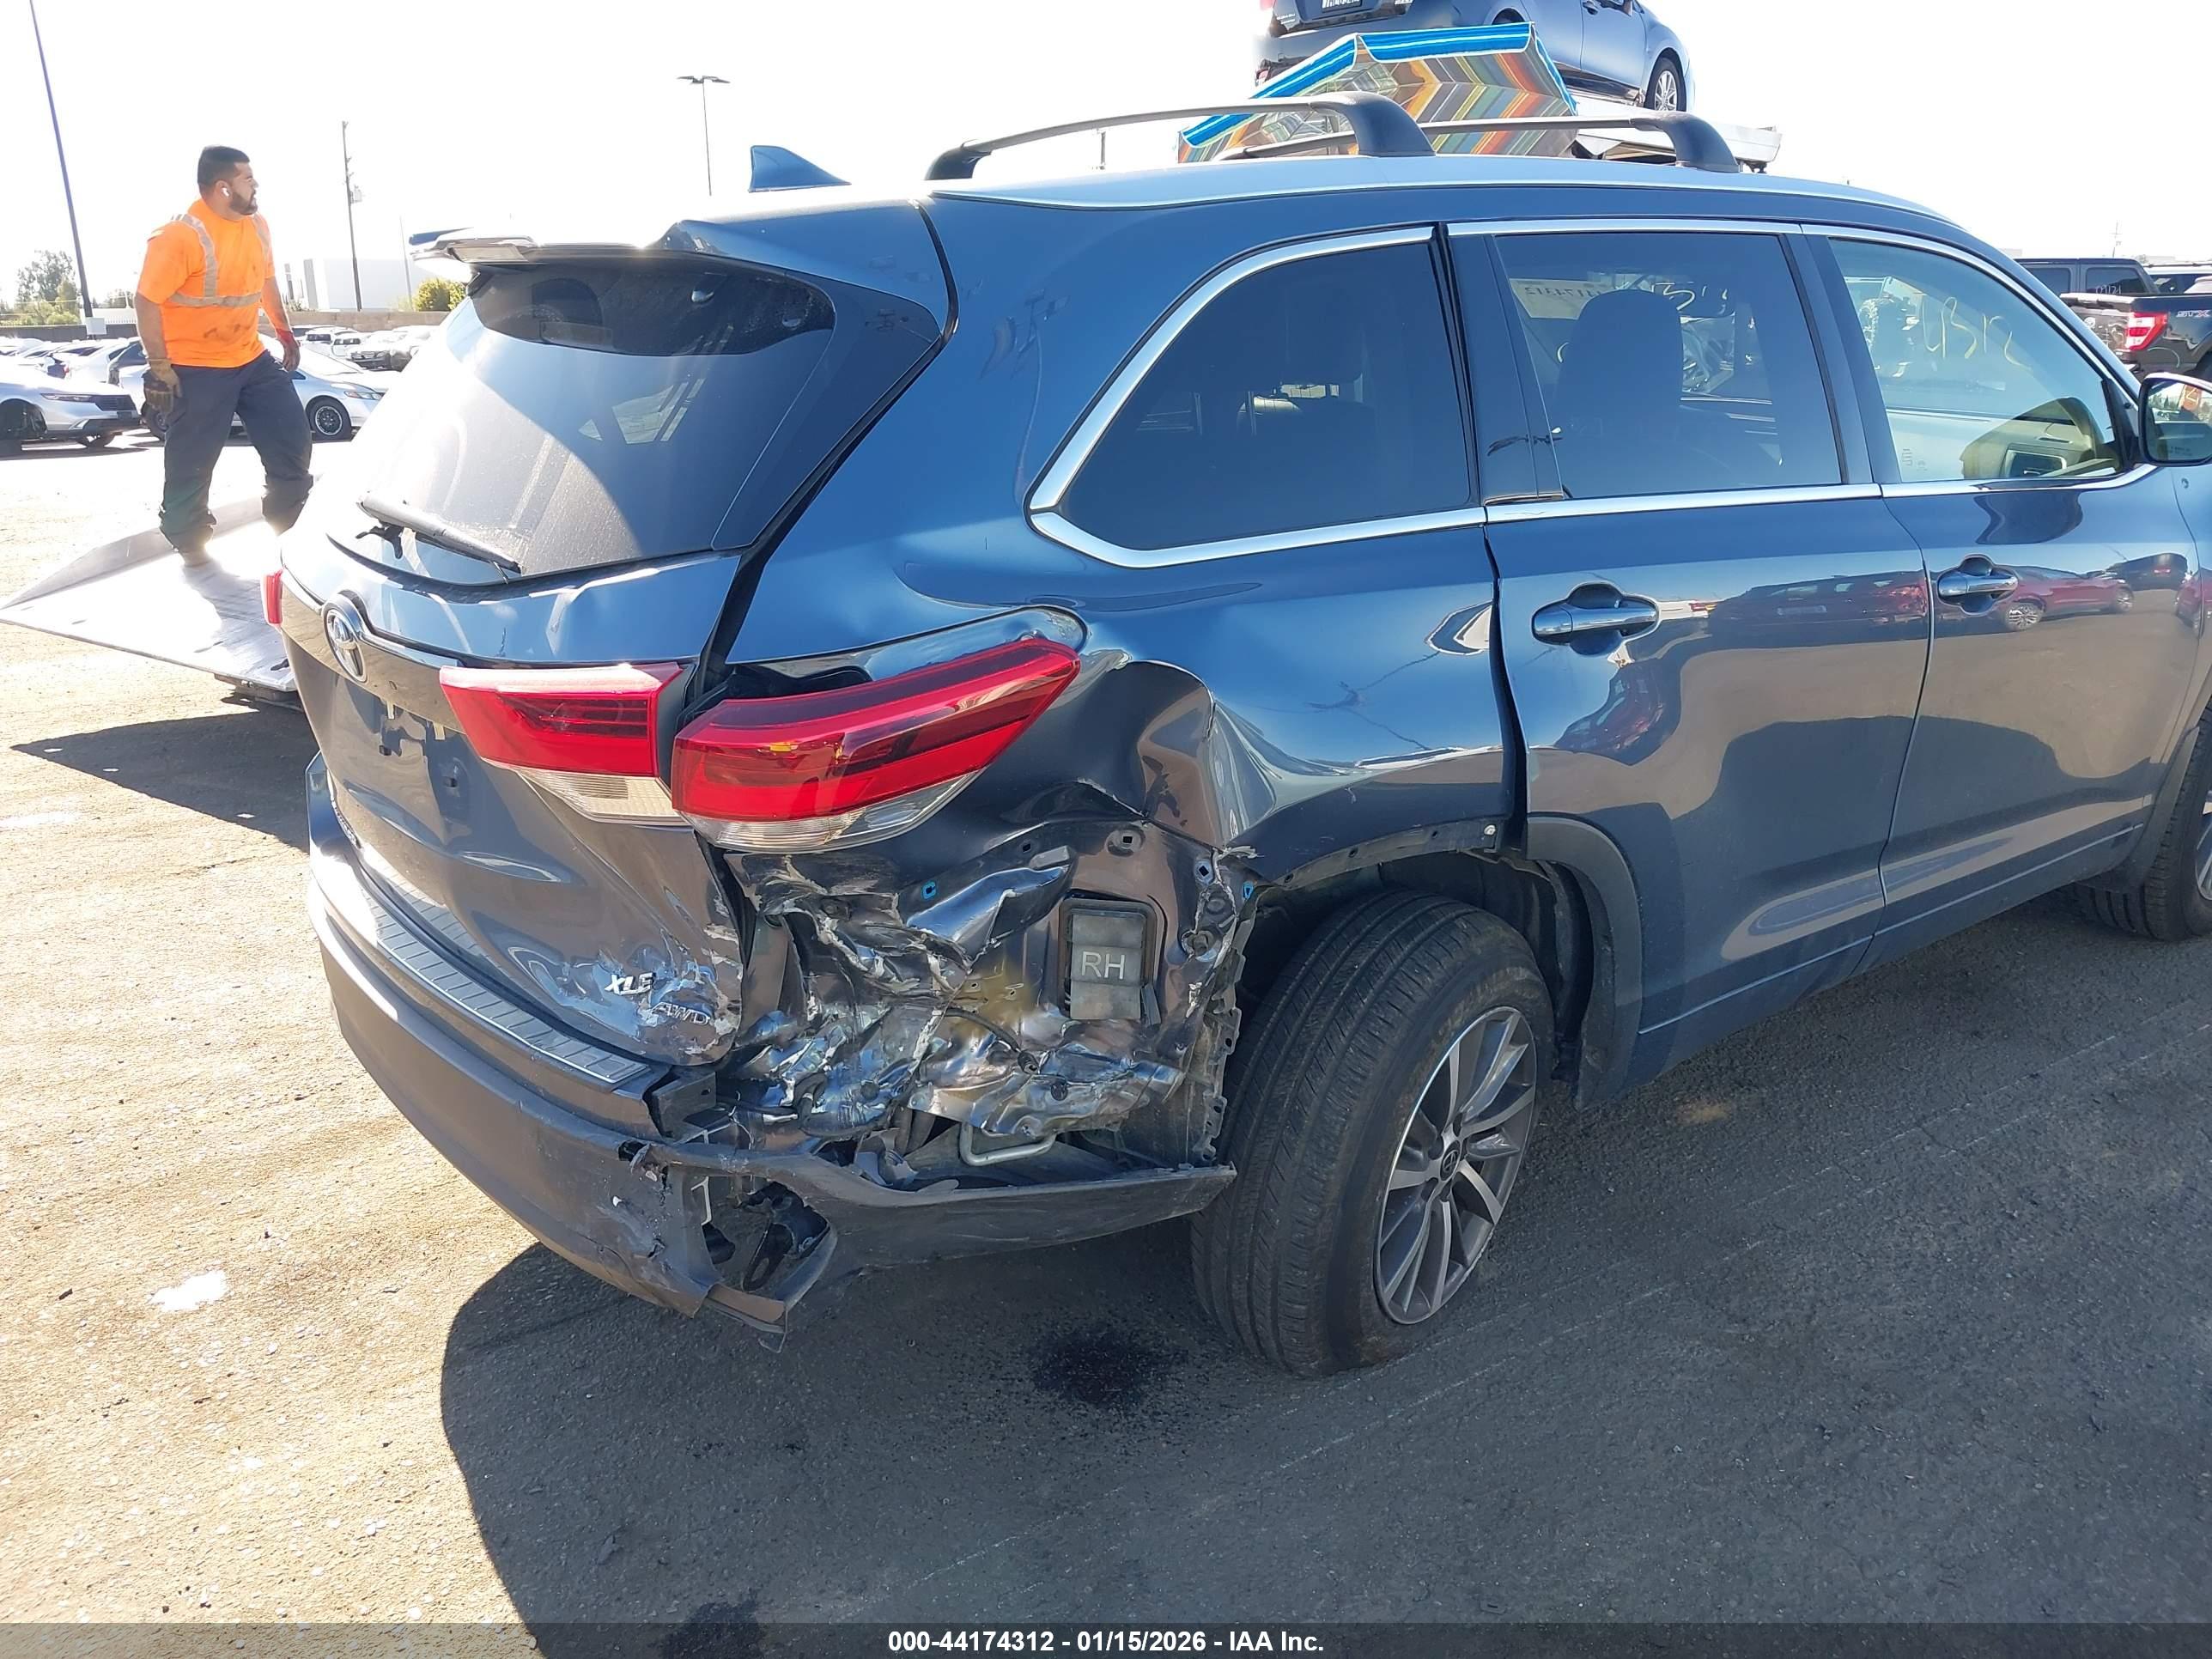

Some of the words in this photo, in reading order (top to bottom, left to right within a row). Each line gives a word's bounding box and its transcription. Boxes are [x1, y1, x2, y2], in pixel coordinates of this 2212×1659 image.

[1081, 951, 1126, 981] RH
[605, 972, 654, 996] XLE
[651, 1001, 711, 1025] AWD
